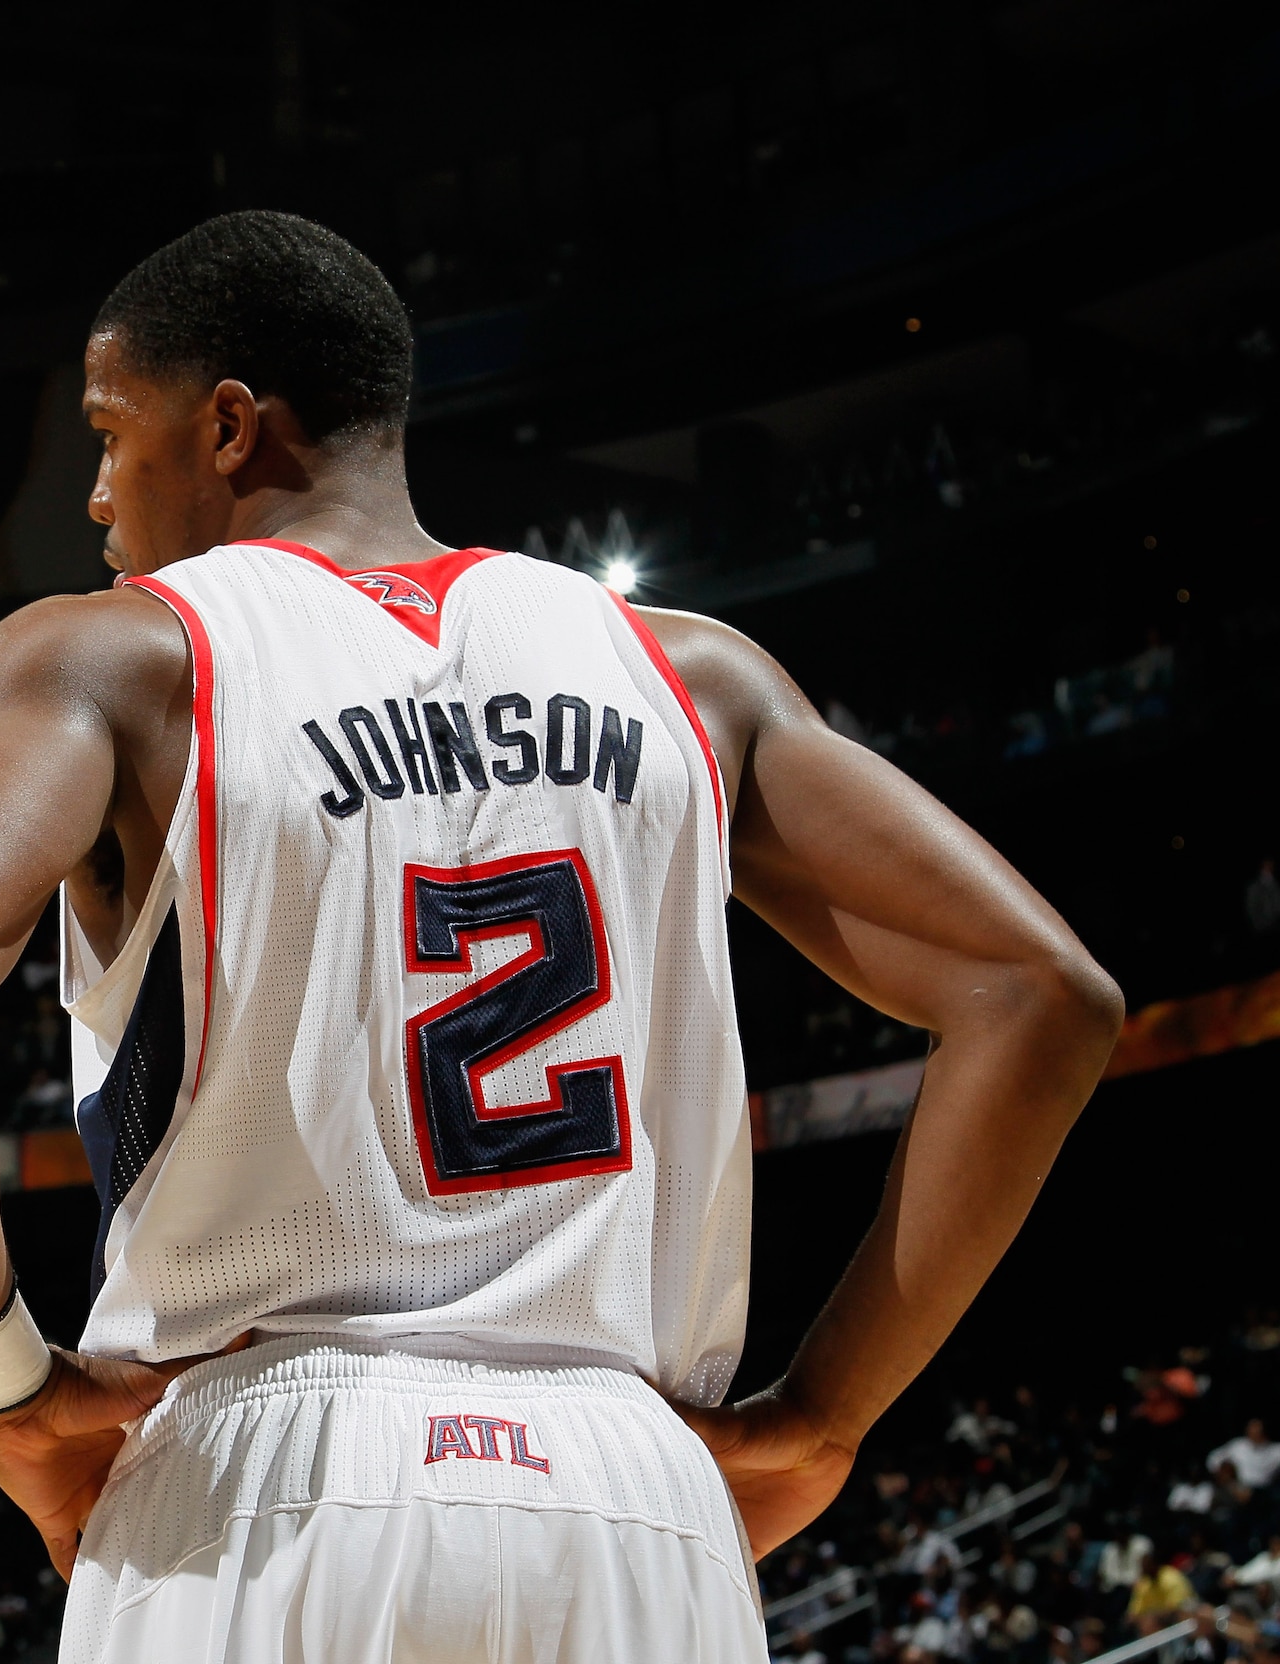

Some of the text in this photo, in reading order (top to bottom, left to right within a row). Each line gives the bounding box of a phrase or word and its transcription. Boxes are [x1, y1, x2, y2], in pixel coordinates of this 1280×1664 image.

[301, 692, 644, 820] JOHNSON
[403, 847, 632, 1197] 2
[424, 1414, 550, 1474] ATL
